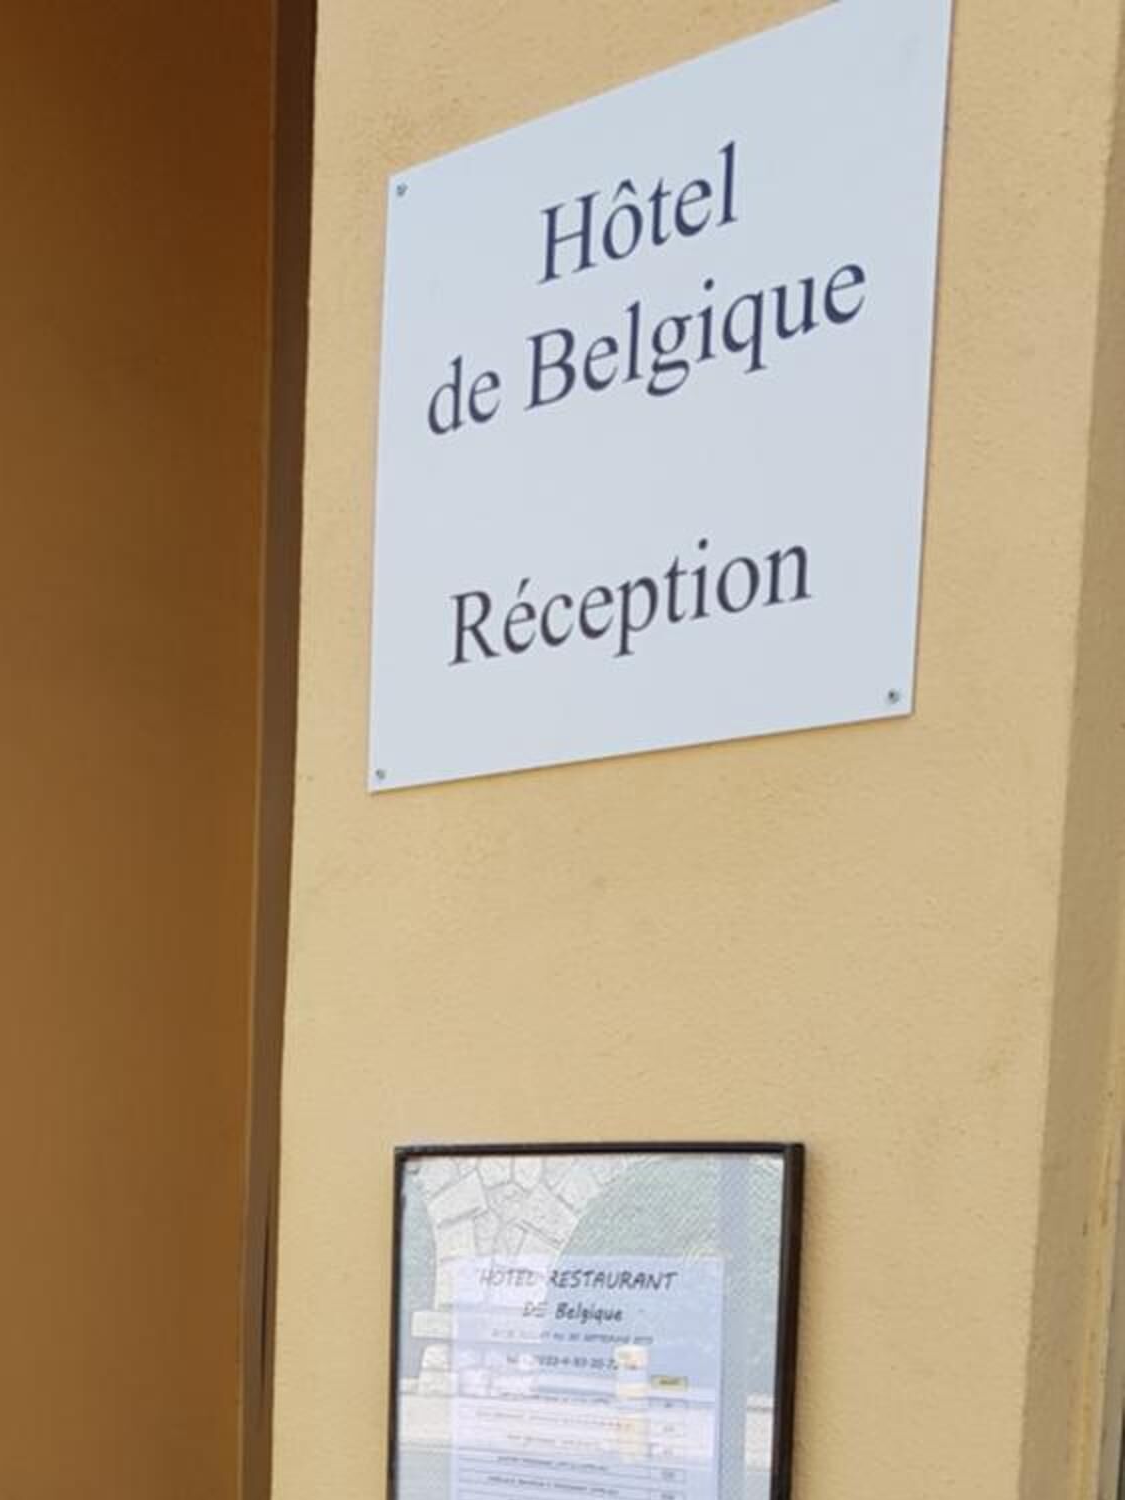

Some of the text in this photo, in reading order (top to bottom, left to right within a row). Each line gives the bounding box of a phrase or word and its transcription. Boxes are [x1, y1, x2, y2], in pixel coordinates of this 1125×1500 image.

[538, 140, 737, 284] Hôtel
[427, 260, 867, 436] de Belgique
[449, 537, 812, 667] Réception
[550, 1269, 678, 1291] RESTAURANT
[554, 1301, 623, 1325] Belgique
